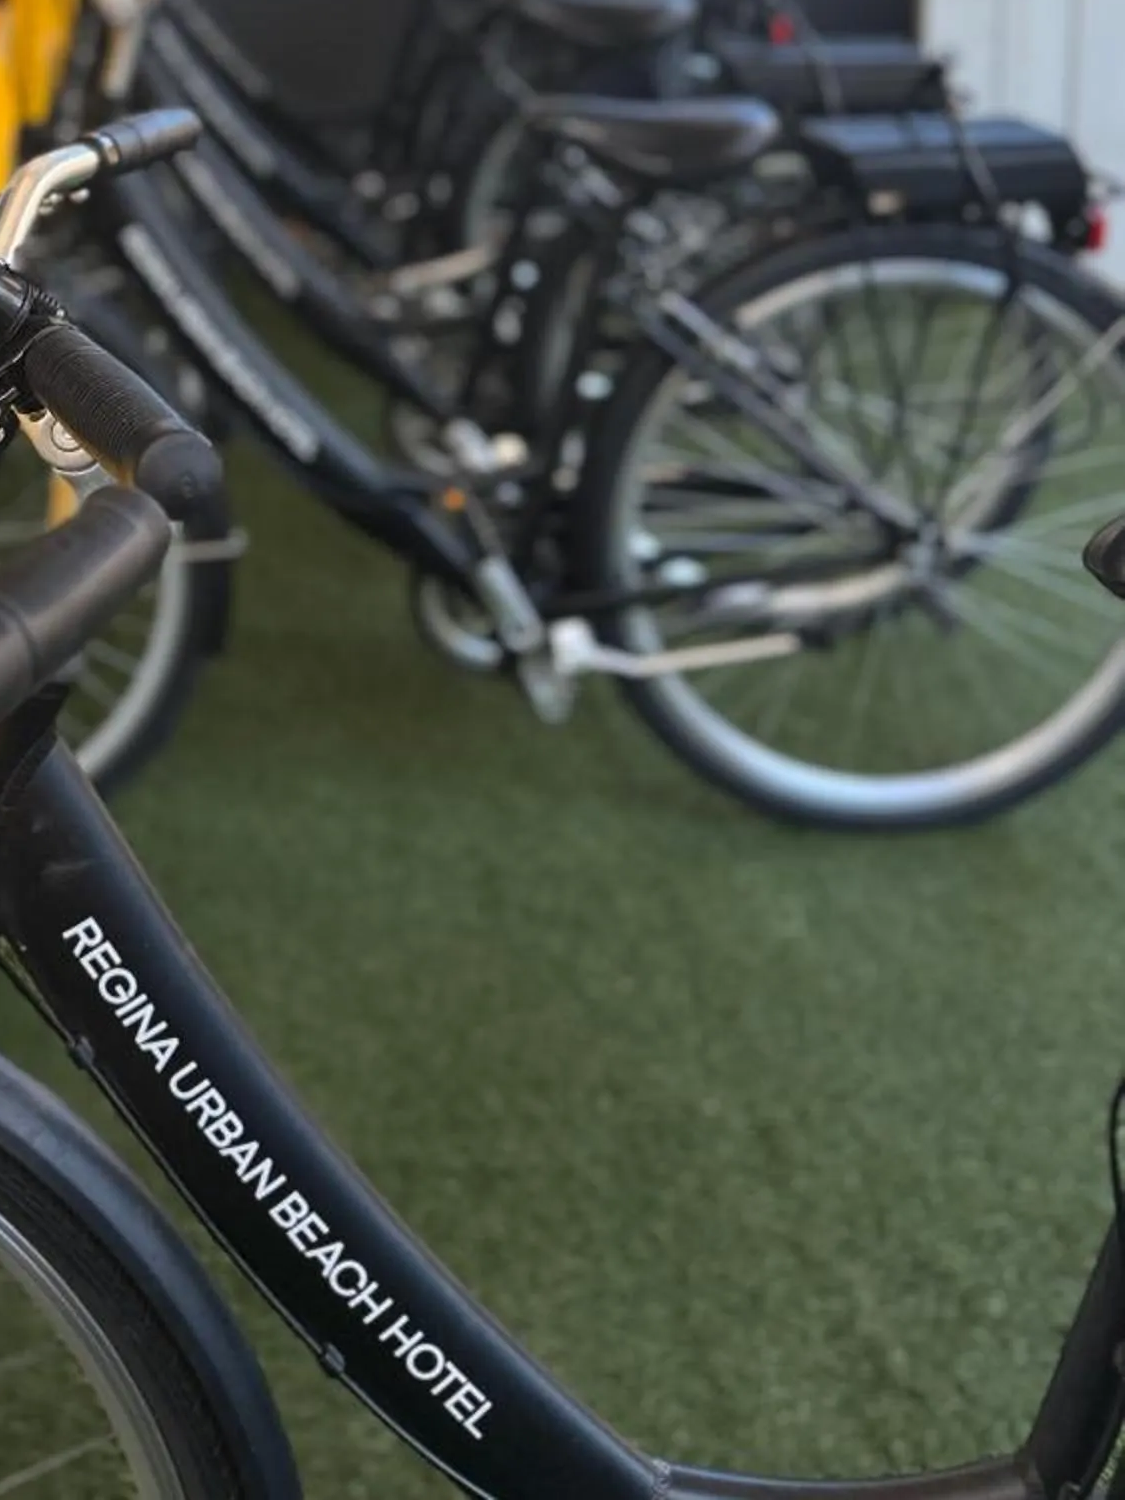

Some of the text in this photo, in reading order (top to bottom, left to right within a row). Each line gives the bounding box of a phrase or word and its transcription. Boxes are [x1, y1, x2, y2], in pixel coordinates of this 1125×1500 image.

[62, 917, 494, 1440] REGINA URBAN BEACH HOTEL
